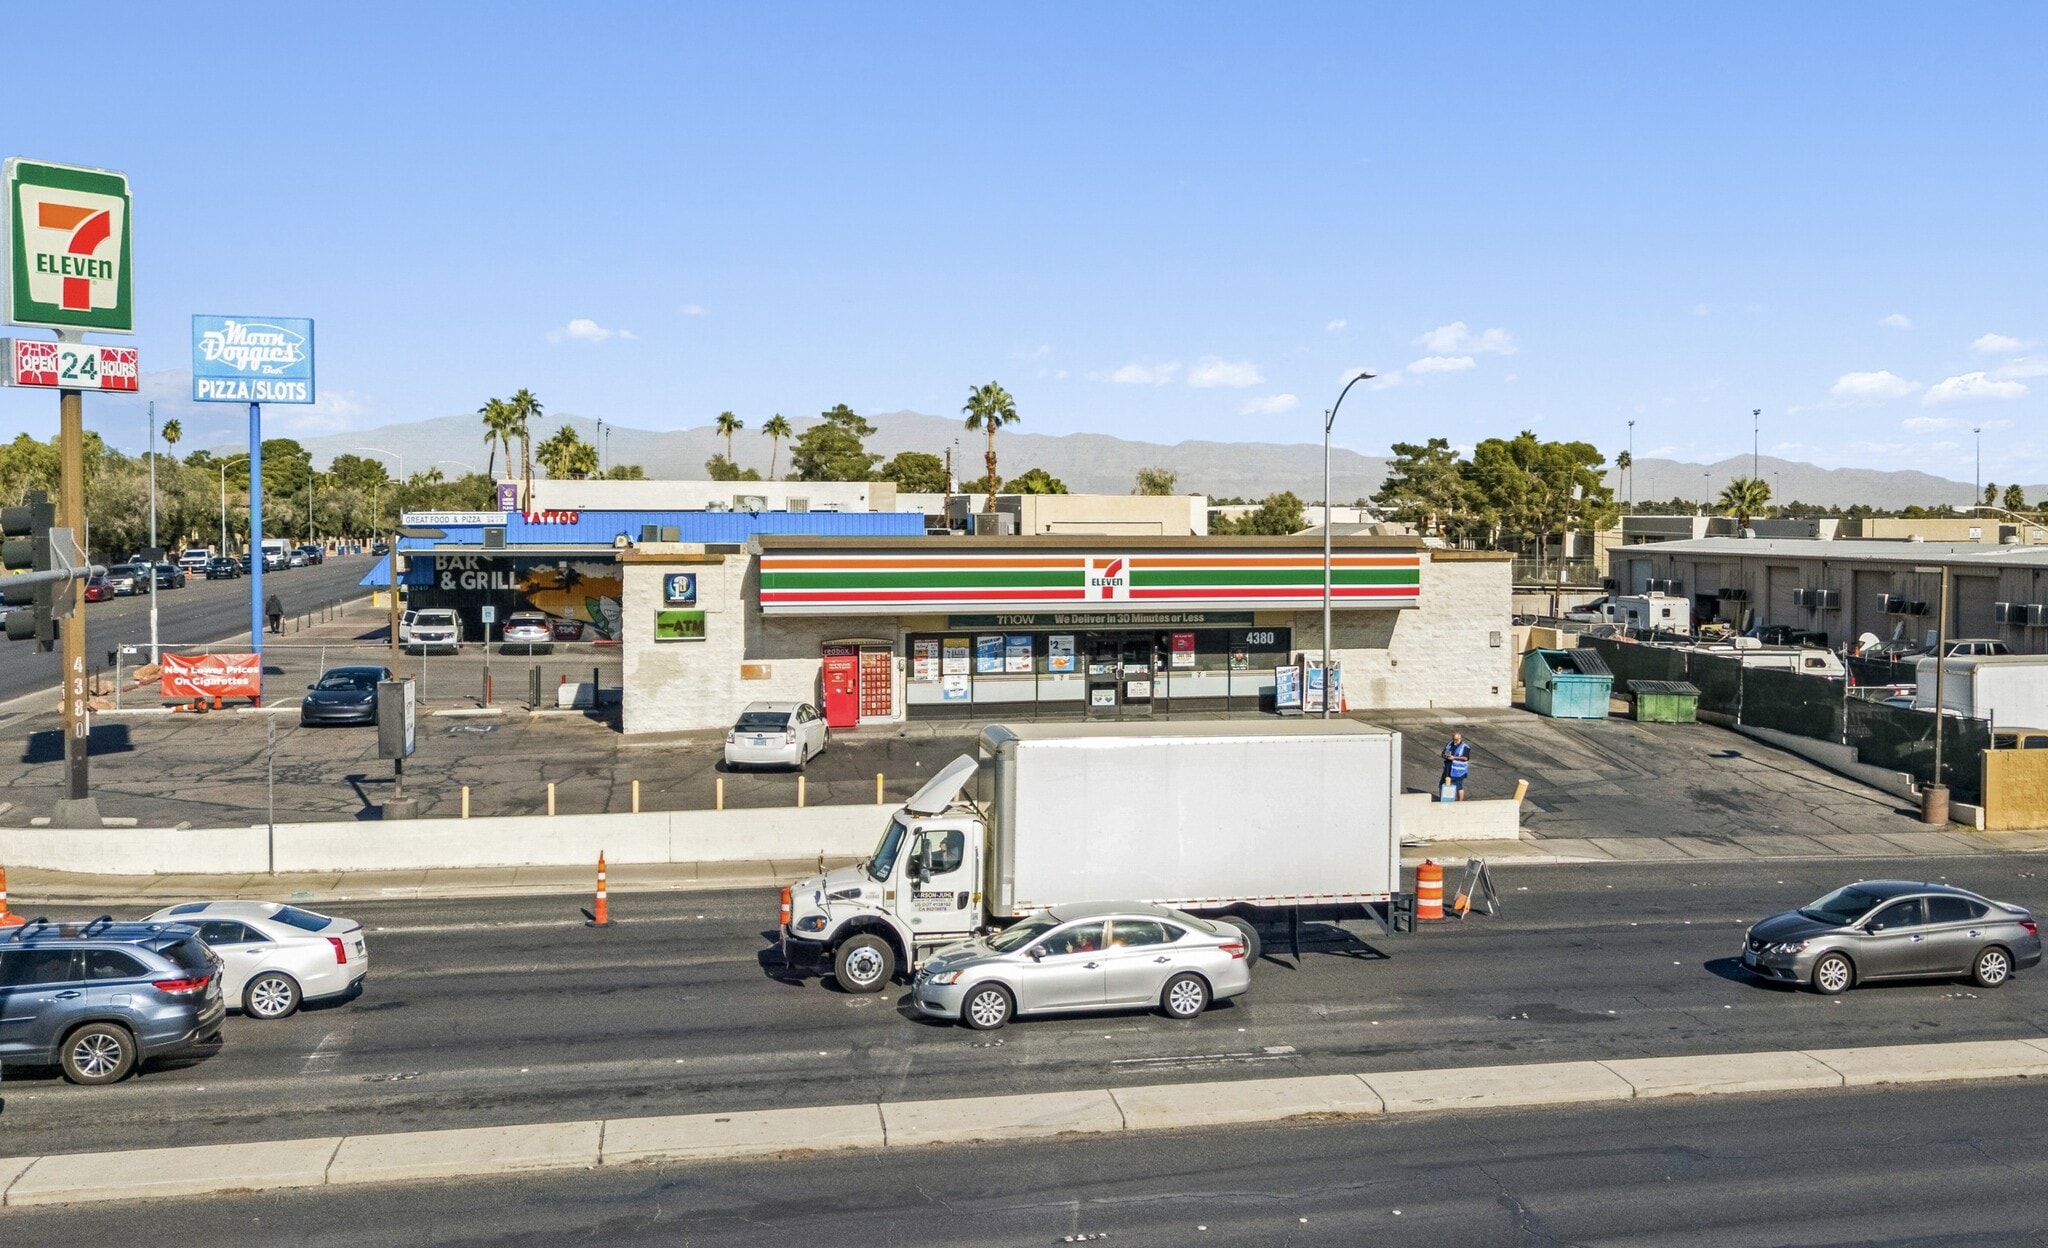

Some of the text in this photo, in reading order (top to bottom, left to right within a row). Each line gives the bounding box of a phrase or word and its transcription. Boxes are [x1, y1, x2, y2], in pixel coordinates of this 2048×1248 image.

[224, 319, 287, 346] Moon
[202, 330, 298, 371] Doggies
[22, 351, 137, 381] OPEN 24 HOURS
[405, 515, 428, 523] GREAT
[430, 515, 450, 523] FOOD
[461, 515, 481, 523] PIZZA
[521, 511, 579, 525] TATTOO
[435, 555, 480, 571] BAR
[440, 571, 520, 590] & GRILL
[1054, 614, 1070, 624] We
[1071, 613, 1105, 624] Deliver
[1106, 613, 1115, 623] in
[1116, 613, 1131, 623] 30
[1131, 613, 1170, 623] Minutes
[1171, 614, 1182, 623] or
[1182, 612, 1205, 622] Less
[673, 620, 705, 632] ATM
[1246, 632, 1274, 644] 4380
[824, 647, 849, 655] redbox
[164, 665, 189, 674] New
[190, 666, 225, 674] Lower
[174, 677, 249, 687] On Cigarettes
[73, 656, 84, 739] 4380
